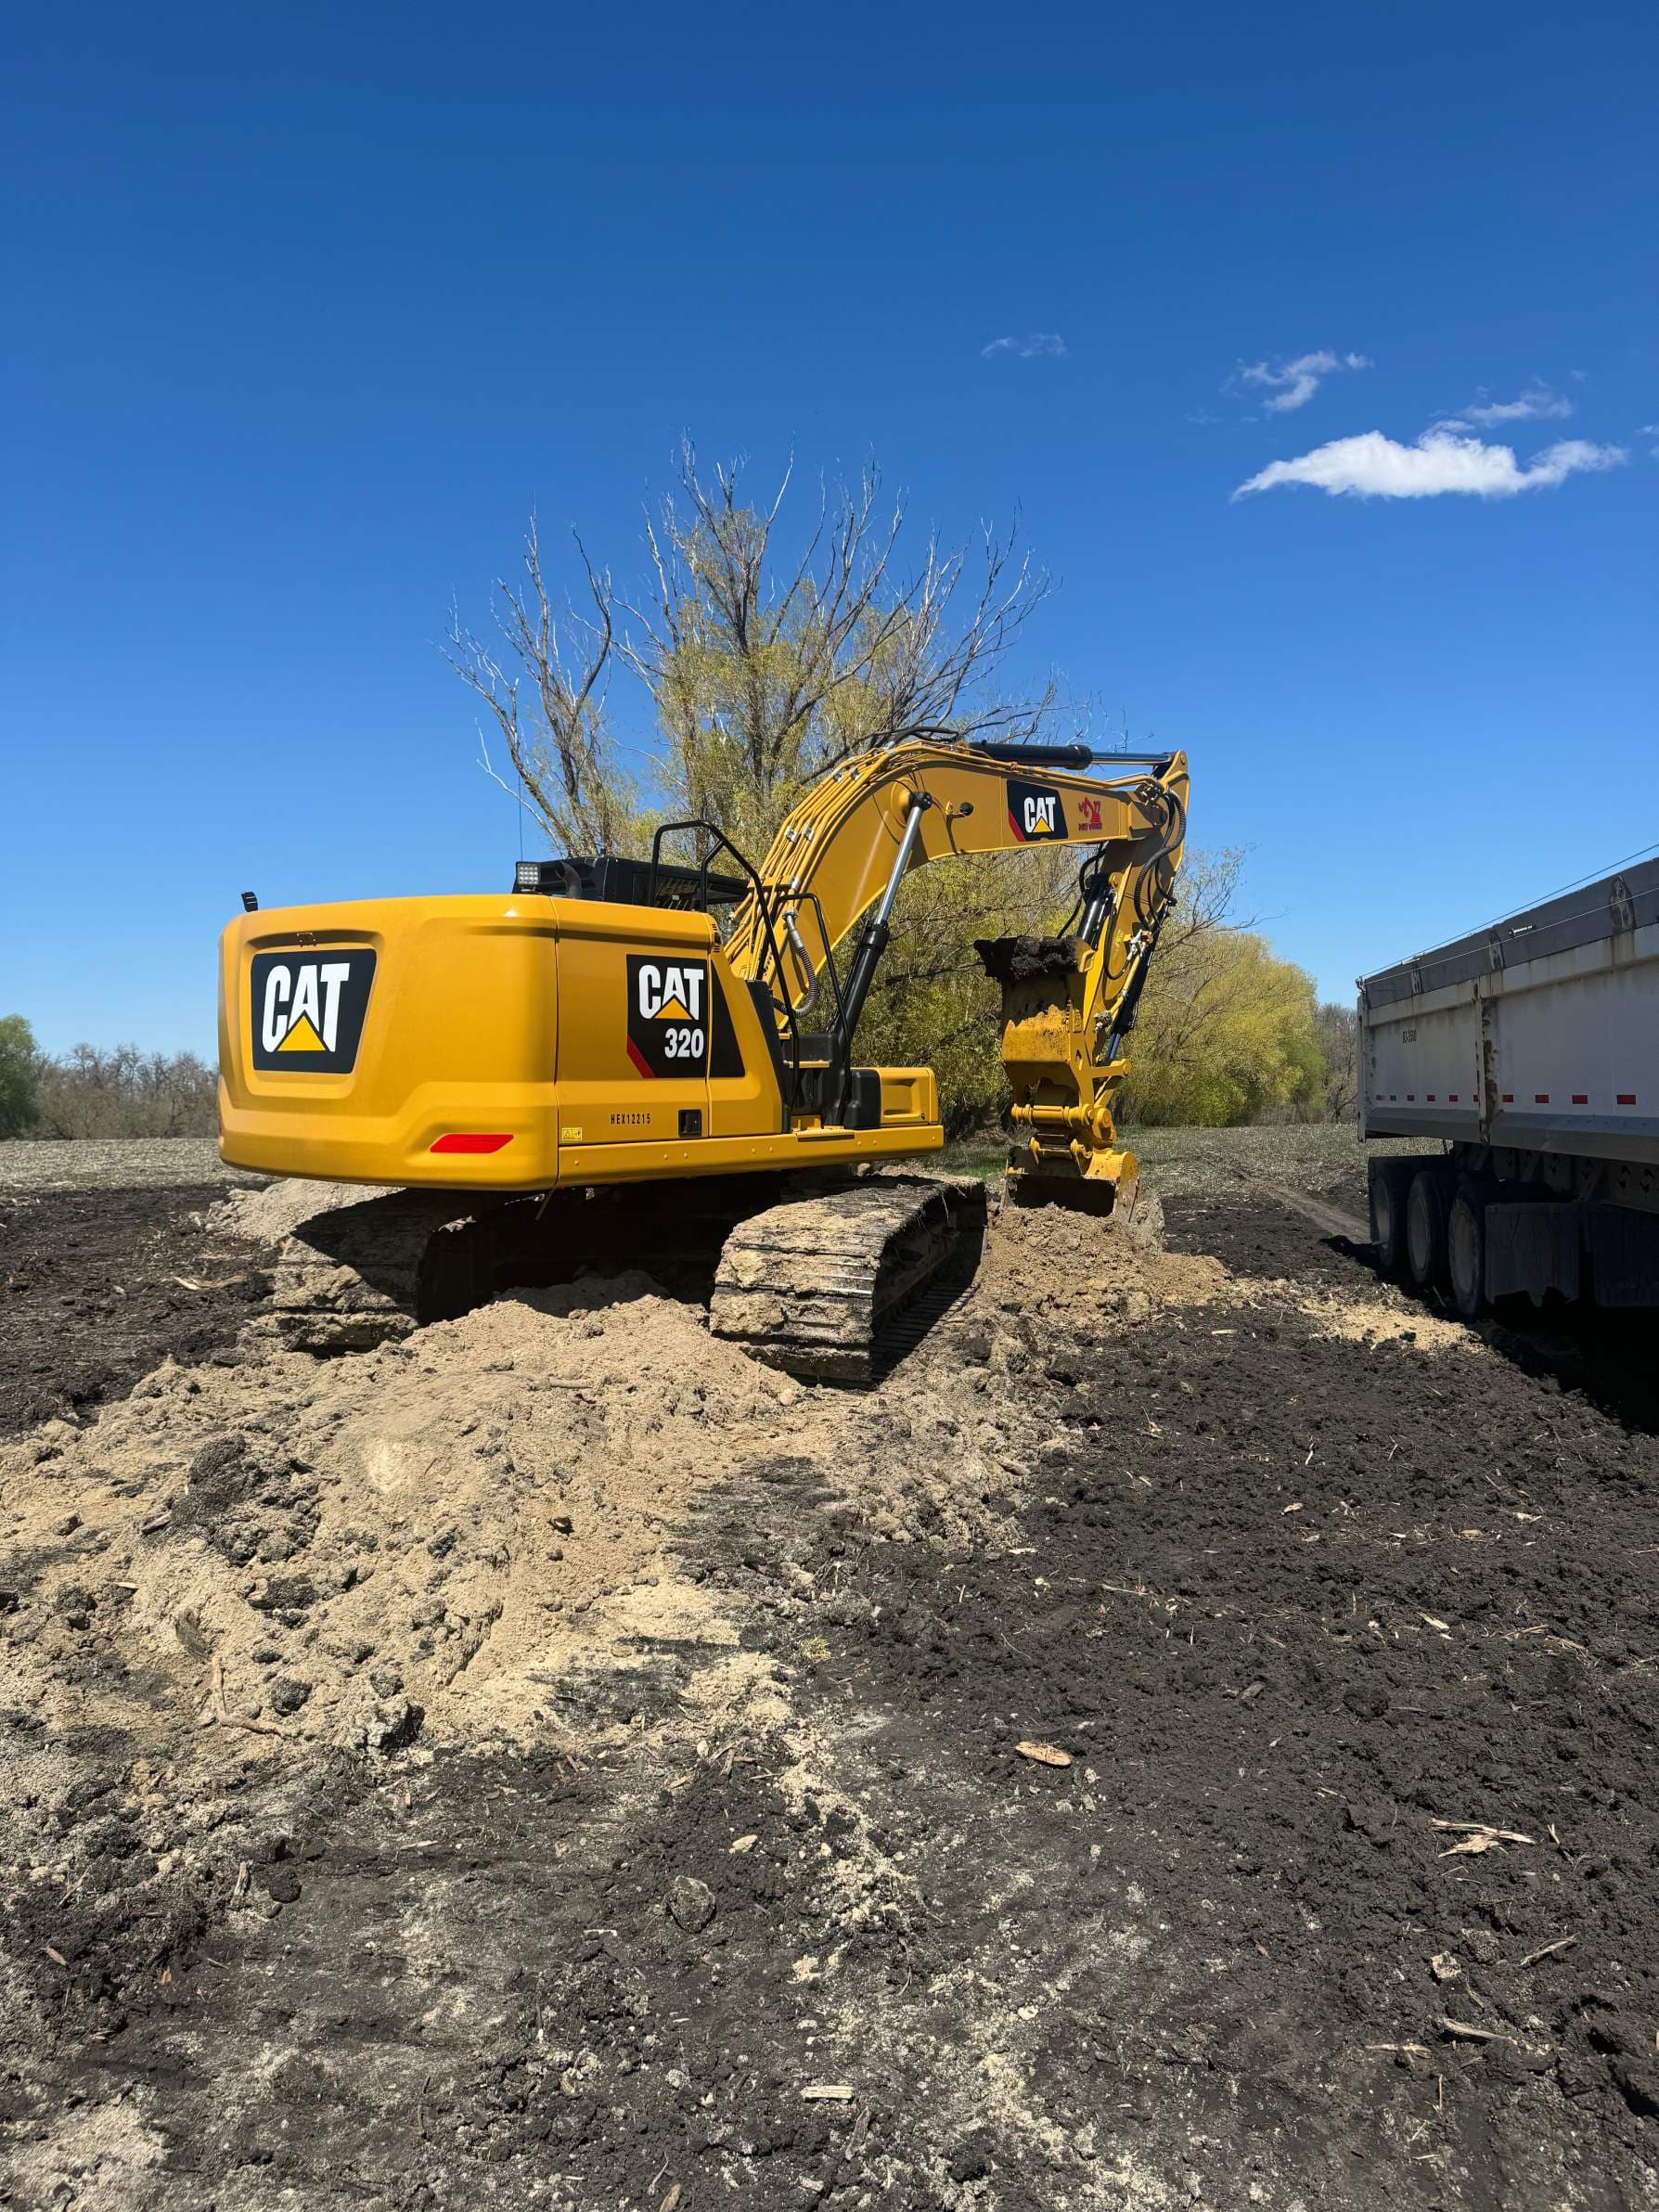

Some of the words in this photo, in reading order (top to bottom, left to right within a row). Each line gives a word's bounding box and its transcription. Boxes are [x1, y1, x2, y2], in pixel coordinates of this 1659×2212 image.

[1023, 796, 1056, 833] CAT
[262, 962, 351, 1053] CAT
[638, 964, 704, 1021] CAT
[664, 1027, 704, 1059] 320
[611, 1112, 651, 1125] HEX12215
